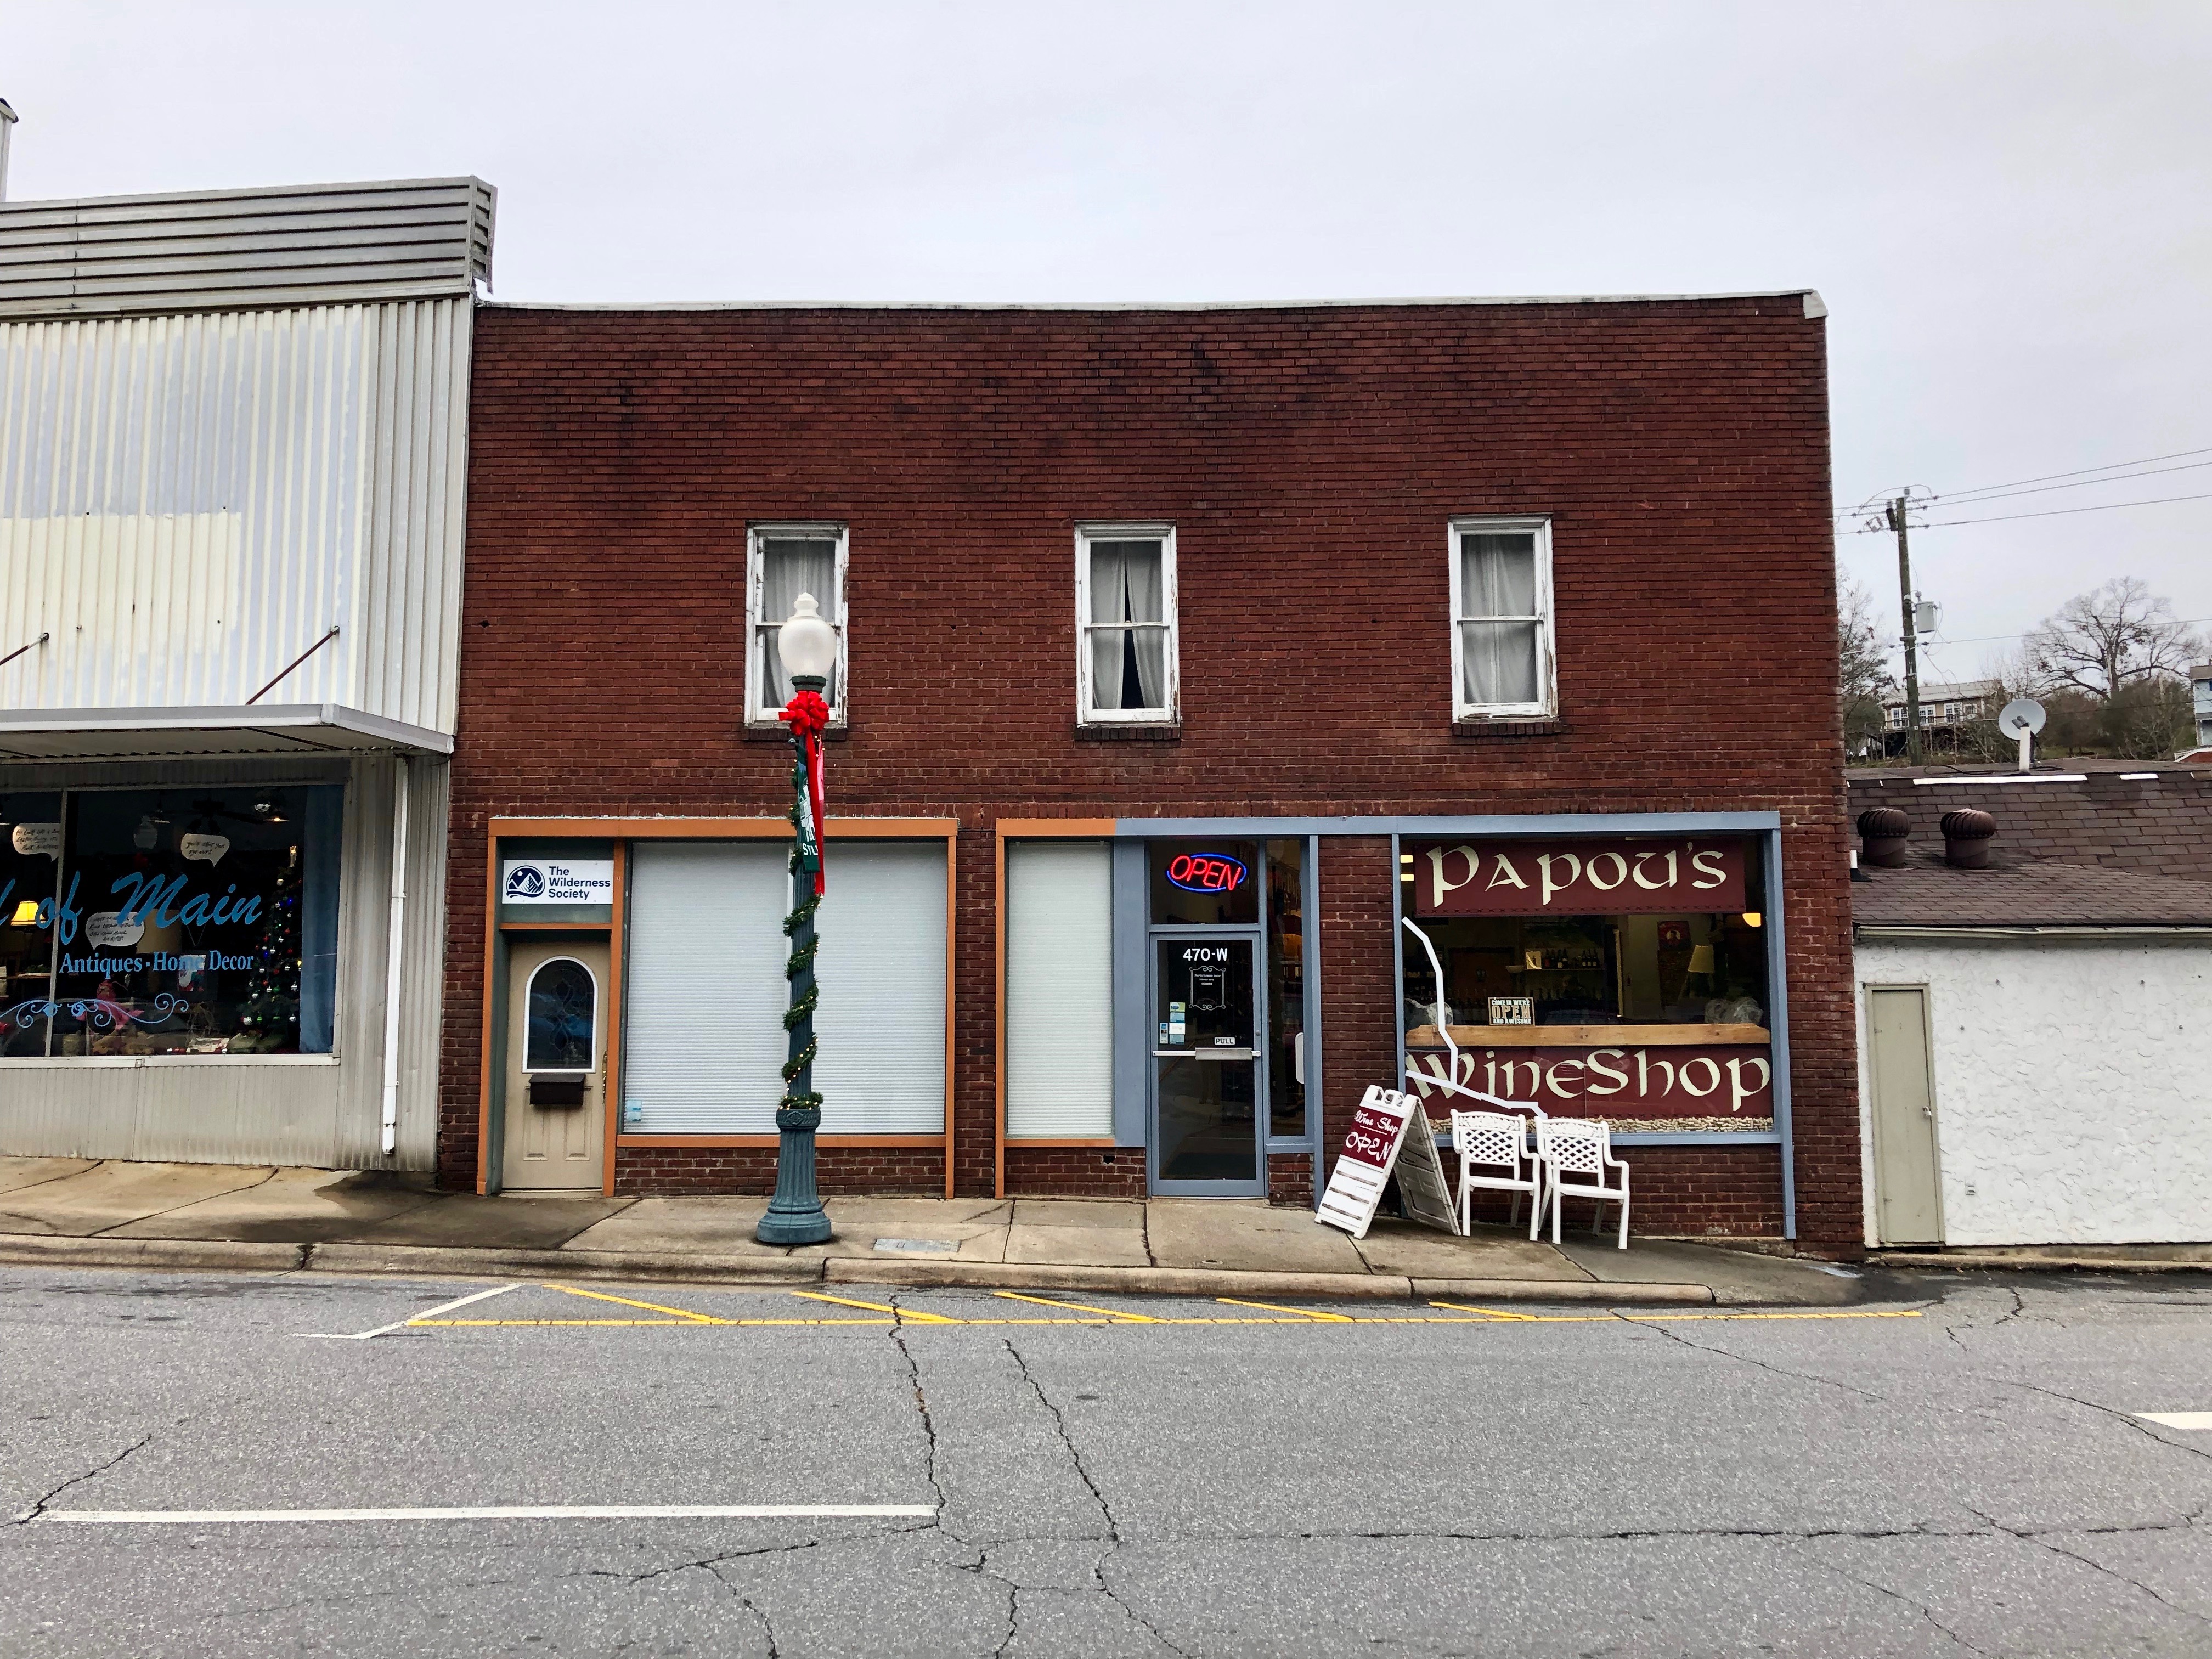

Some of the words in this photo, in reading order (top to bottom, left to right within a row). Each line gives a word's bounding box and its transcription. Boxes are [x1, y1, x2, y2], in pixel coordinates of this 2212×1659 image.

[549, 866, 569, 876] The
[1170, 855, 1242, 891] OPEN
[549, 877, 611, 887] Wilderness
[548, 888, 590, 900] Society
[35, 870, 83, 945] of
[111, 871, 262, 928] Main
[59, 952, 143, 979] Antiques
[152, 951, 205, 971] Home
[209, 950, 255, 971] Decor
[1183, 948, 1228, 961] 470-W
[1492, 1005, 1531, 1019] OPEN
[1355, 1110, 1374, 1126] Wine
[1377, 1117, 1398, 1137] Shop
[1345, 1131, 1393, 1161] OPEN
